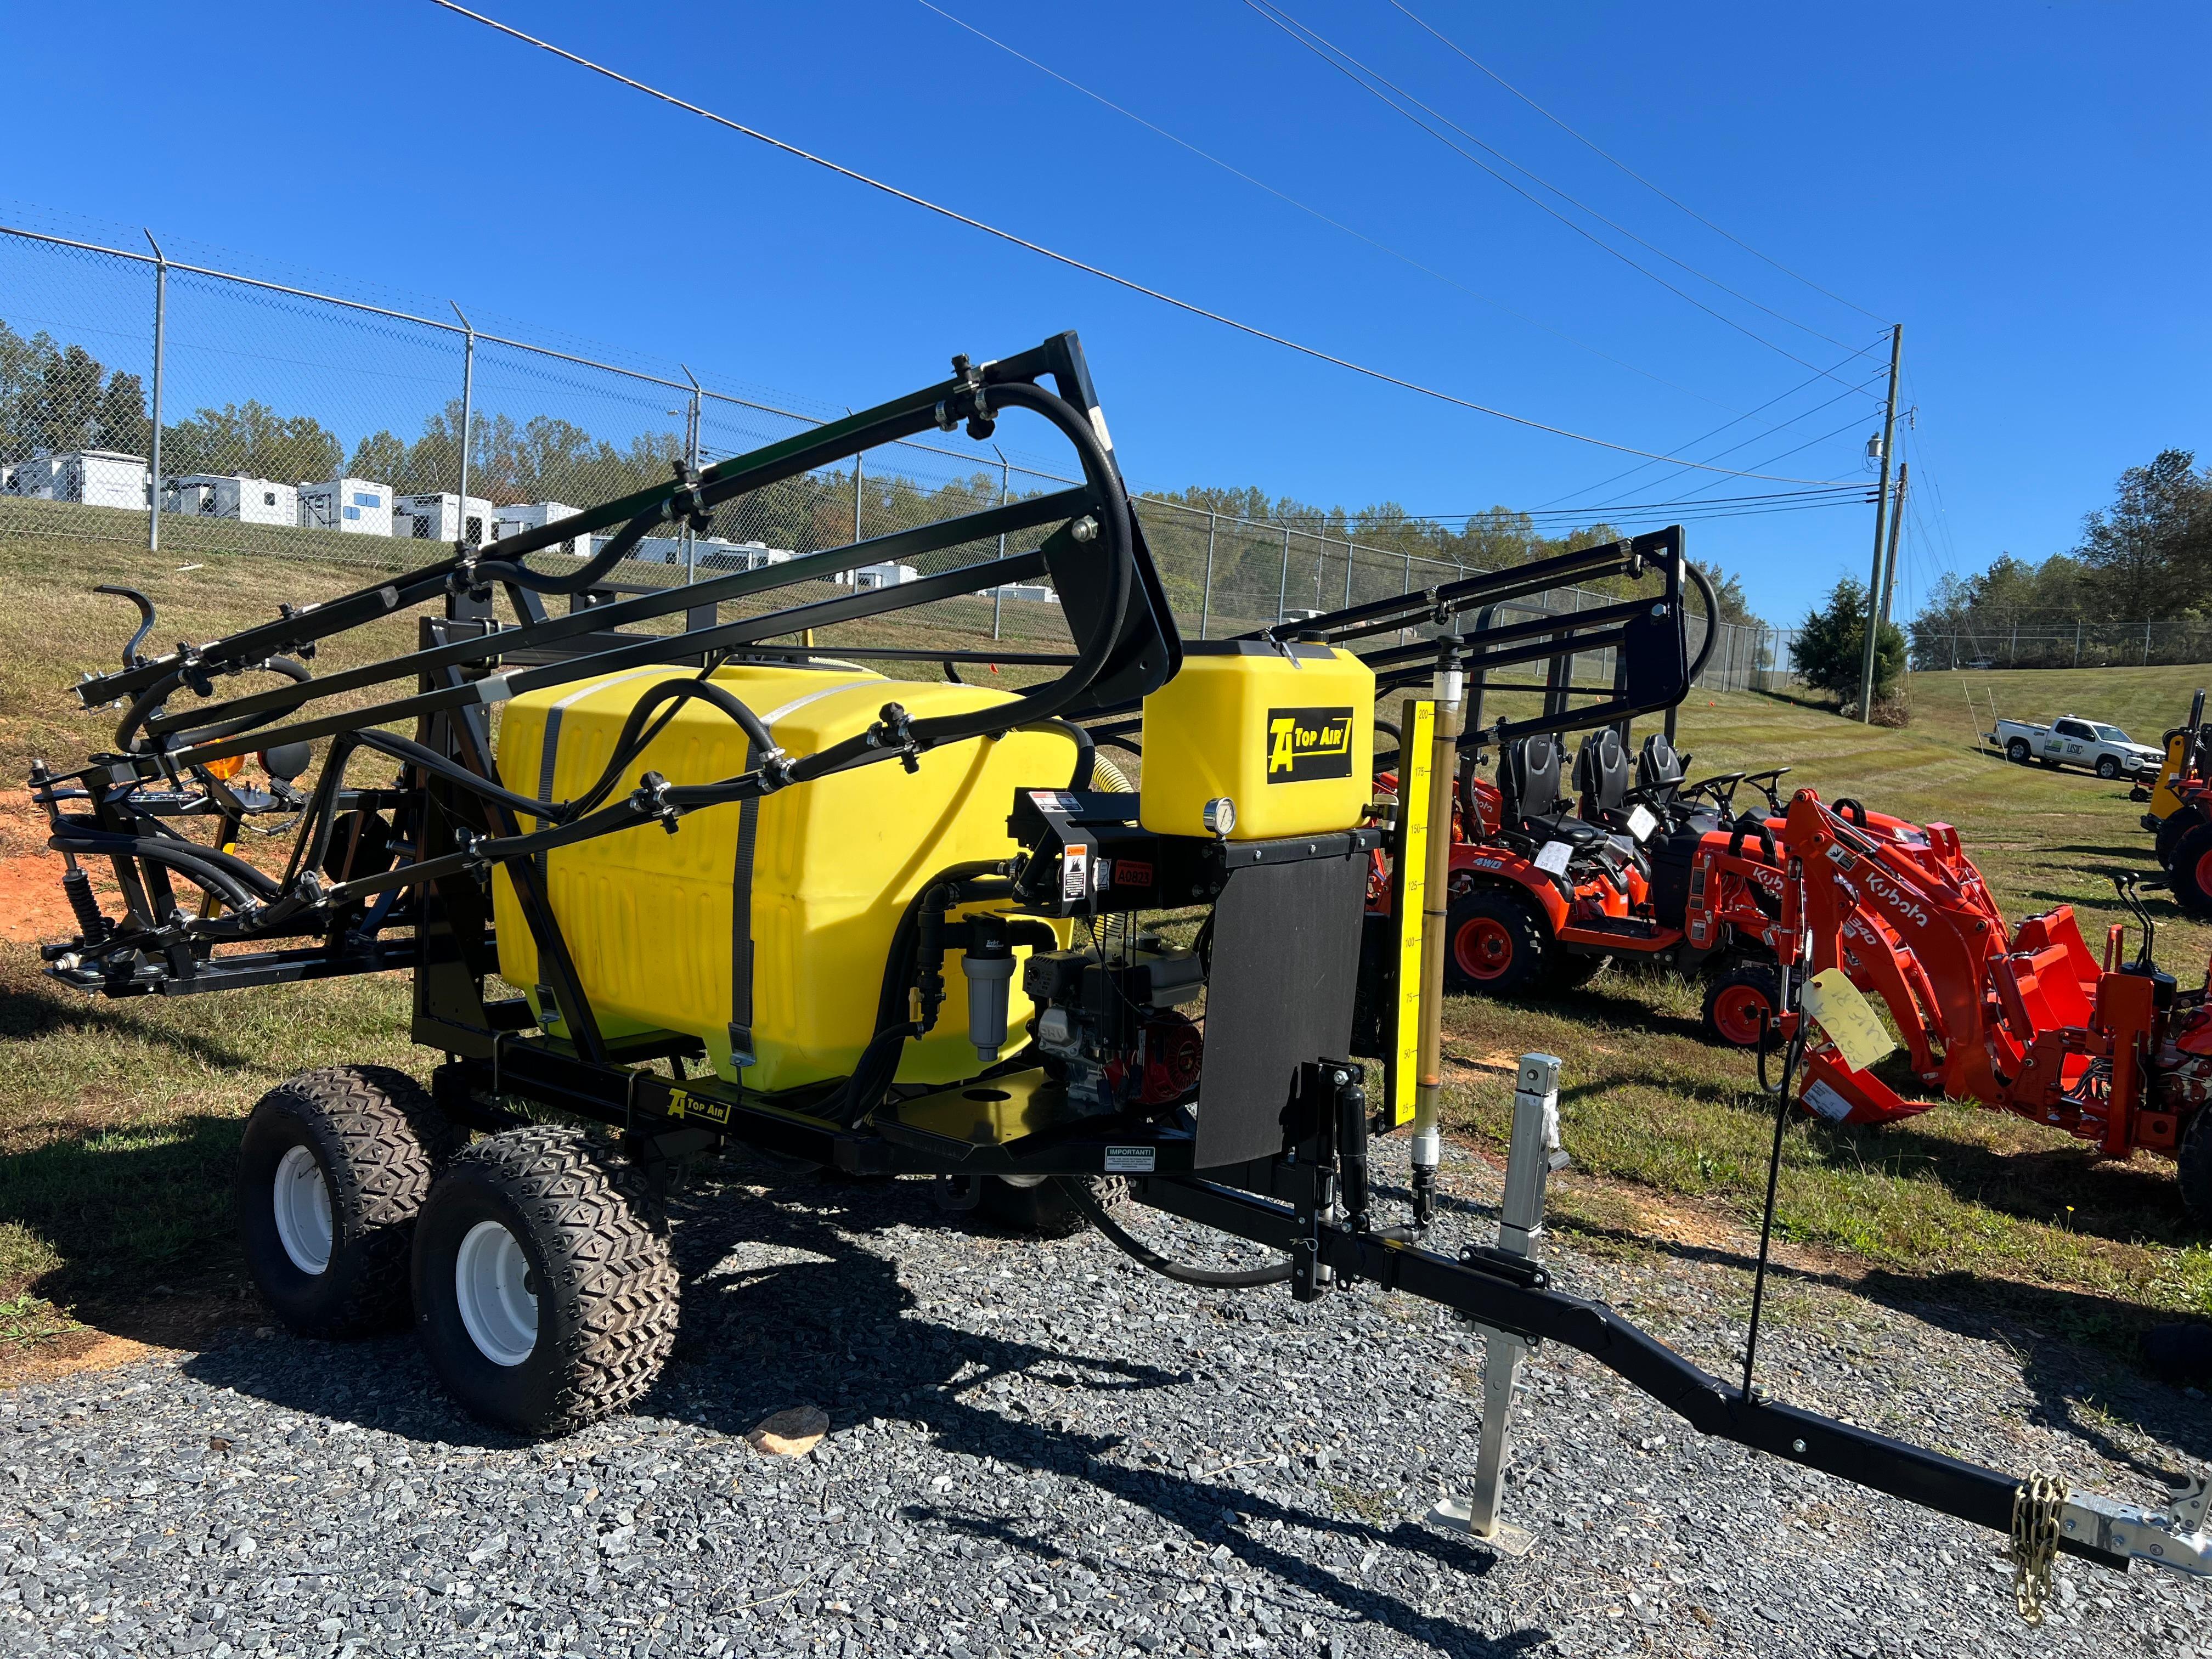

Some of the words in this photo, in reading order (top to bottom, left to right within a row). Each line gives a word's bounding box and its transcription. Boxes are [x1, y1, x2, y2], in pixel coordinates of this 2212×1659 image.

[1419, 709, 1429, 720] 200
[2067, 743, 2083, 755] USIC
[1415, 766, 1425, 777] 175
[1411, 823, 1421, 834] 150
[1472, 857, 1503, 870] 4WD
[1118, 870, 1149, 884] A0823
[1408, 880, 1418, 891] 125
[1865, 871, 1928, 928] Kubota
[1405, 937, 1415, 948] 100
[1406, 992, 1413, 1003] 75
[1403, 1048, 1411, 1059] 50
[1402, 1104, 1409, 1114] 25
